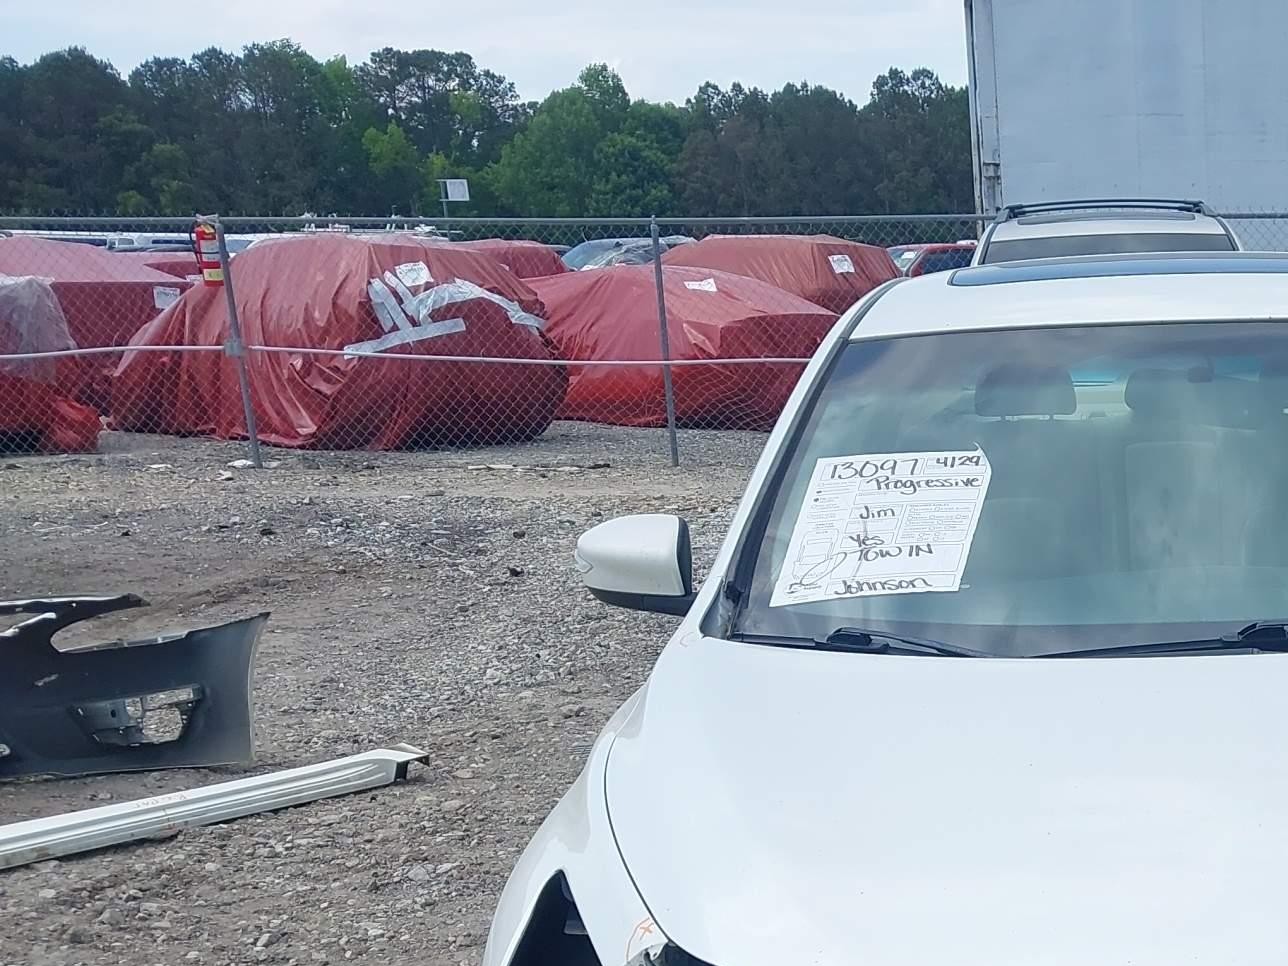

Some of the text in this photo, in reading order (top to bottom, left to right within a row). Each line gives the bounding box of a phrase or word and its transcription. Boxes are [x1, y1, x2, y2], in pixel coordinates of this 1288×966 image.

[830, 458, 919, 479] 13097
[866, 475, 982, 495] Progressive
[859, 505, 896, 520] Jim
[849, 533, 885, 548] Yes
[908, 544, 933, 557] IN
[833, 576, 933, 596] Johnson
